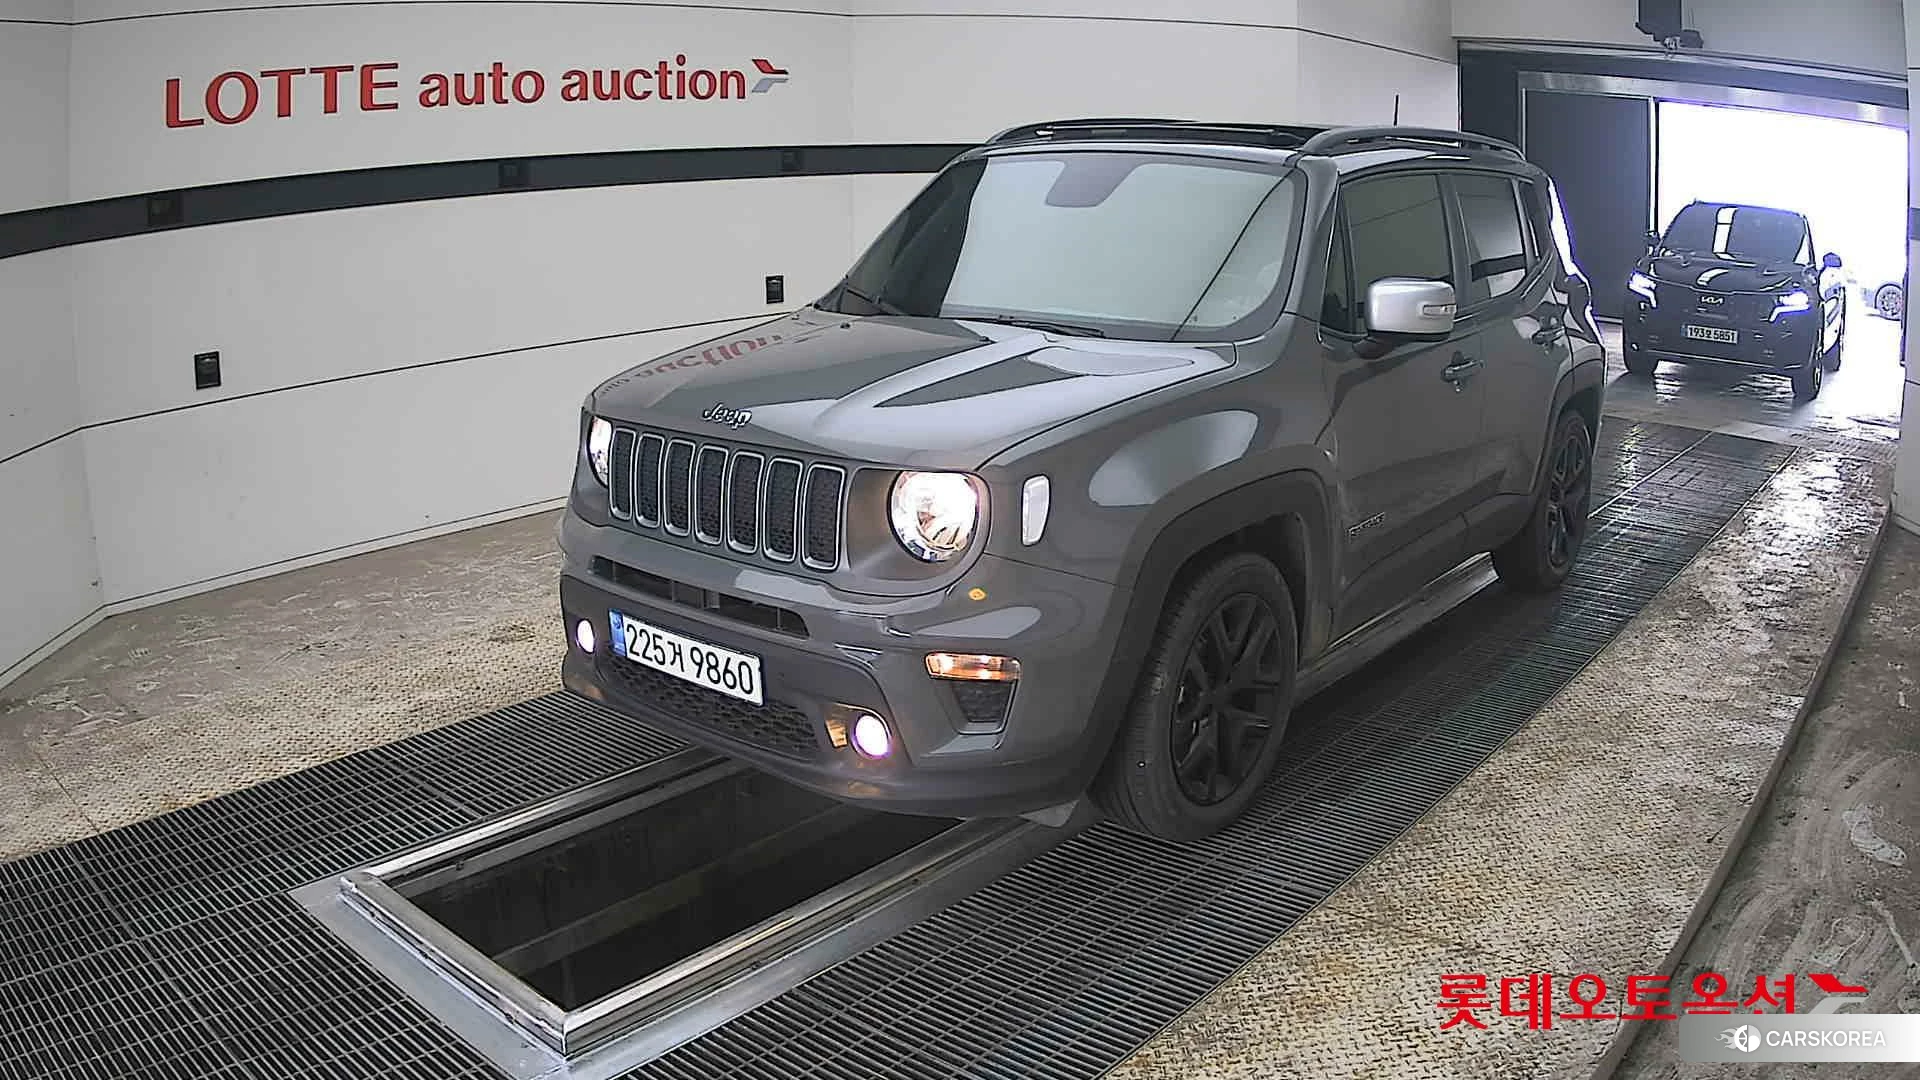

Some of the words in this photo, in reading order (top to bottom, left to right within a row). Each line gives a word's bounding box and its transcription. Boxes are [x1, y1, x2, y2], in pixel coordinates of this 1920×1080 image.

[165, 62, 400, 129] LOTTE
[418, 61, 546, 108] auto
[560, 54, 747, 103] auction
[703, 402, 753, 429] Jeep
[626, 623, 685, 673] 225거
[689, 646, 754, 695] 9860
